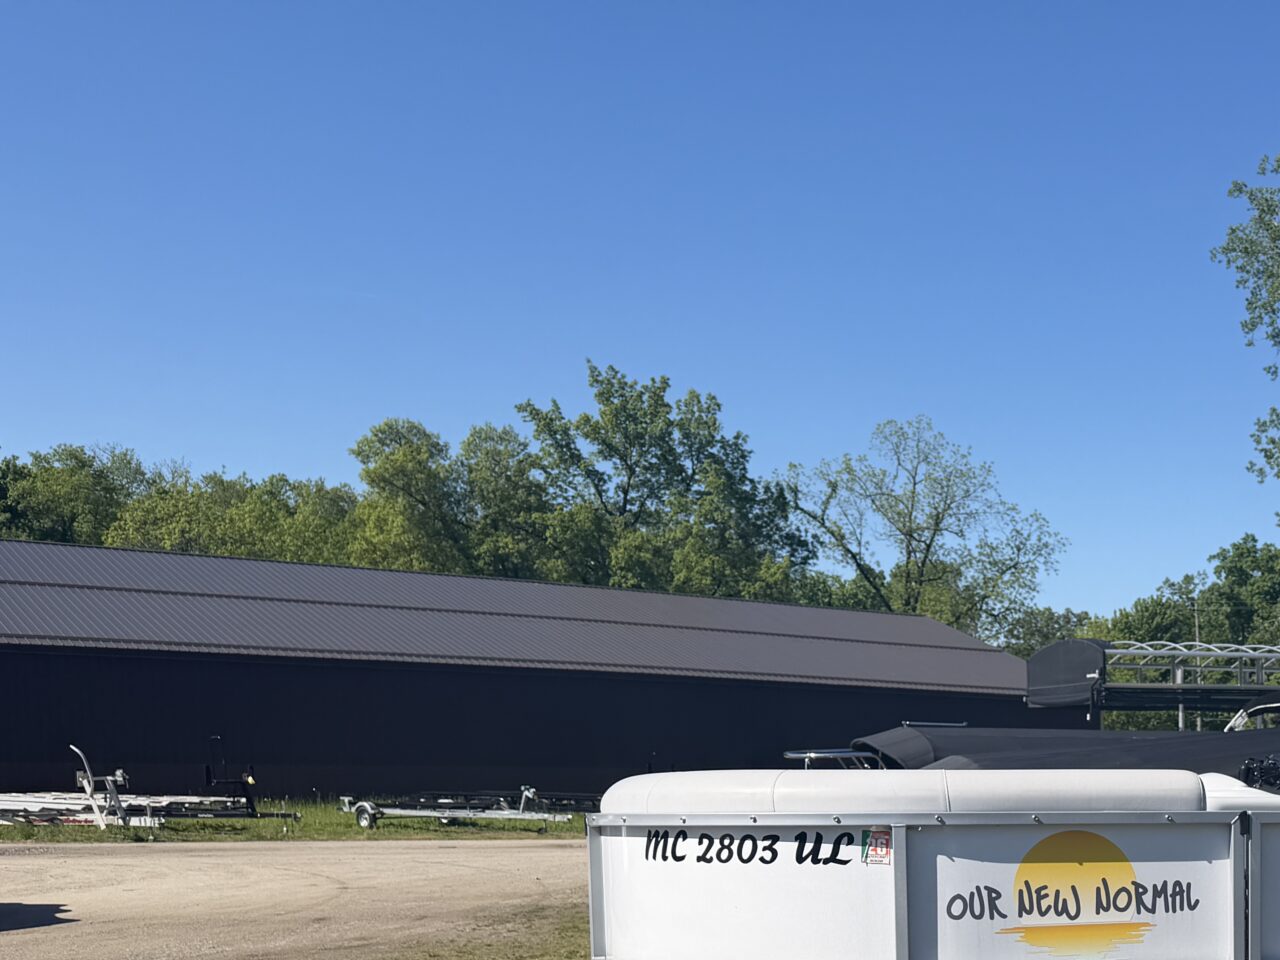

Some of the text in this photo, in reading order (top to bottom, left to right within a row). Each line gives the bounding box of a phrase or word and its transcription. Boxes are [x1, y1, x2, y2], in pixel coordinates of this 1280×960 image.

[645, 829, 855, 866] MC 2803 UL
[946, 877, 1200, 921] OUR NEW NORMAL
